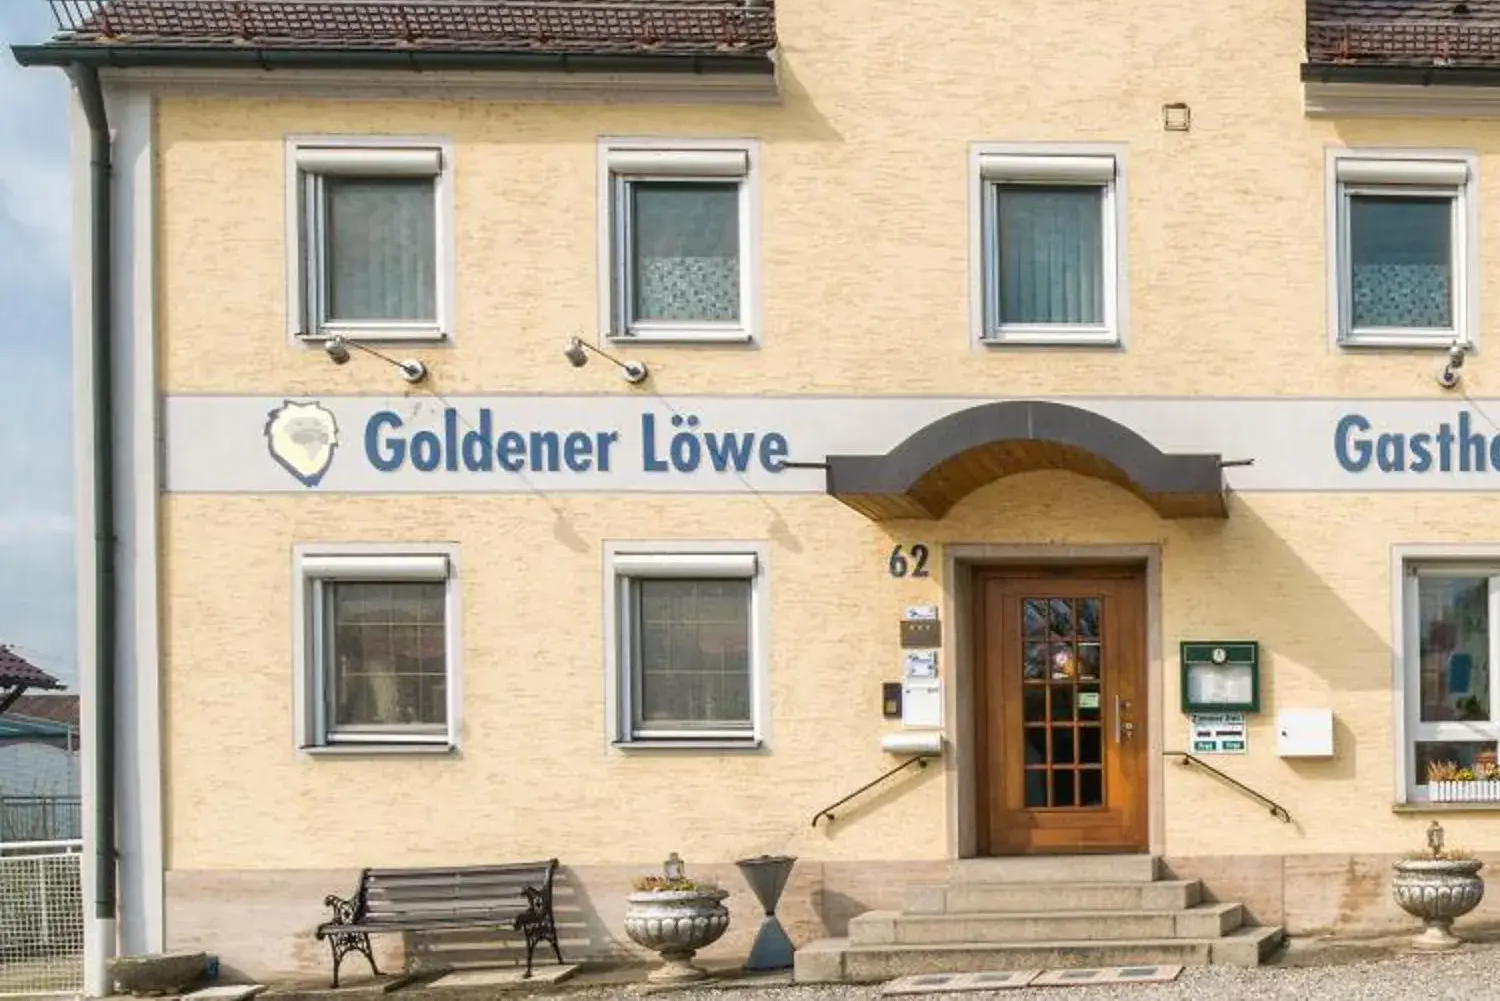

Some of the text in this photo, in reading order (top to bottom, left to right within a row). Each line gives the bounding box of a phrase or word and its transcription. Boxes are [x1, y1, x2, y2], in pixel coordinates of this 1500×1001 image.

[364, 407, 790, 473] Goldener Löwe
[889, 544, 929, 578] 62
